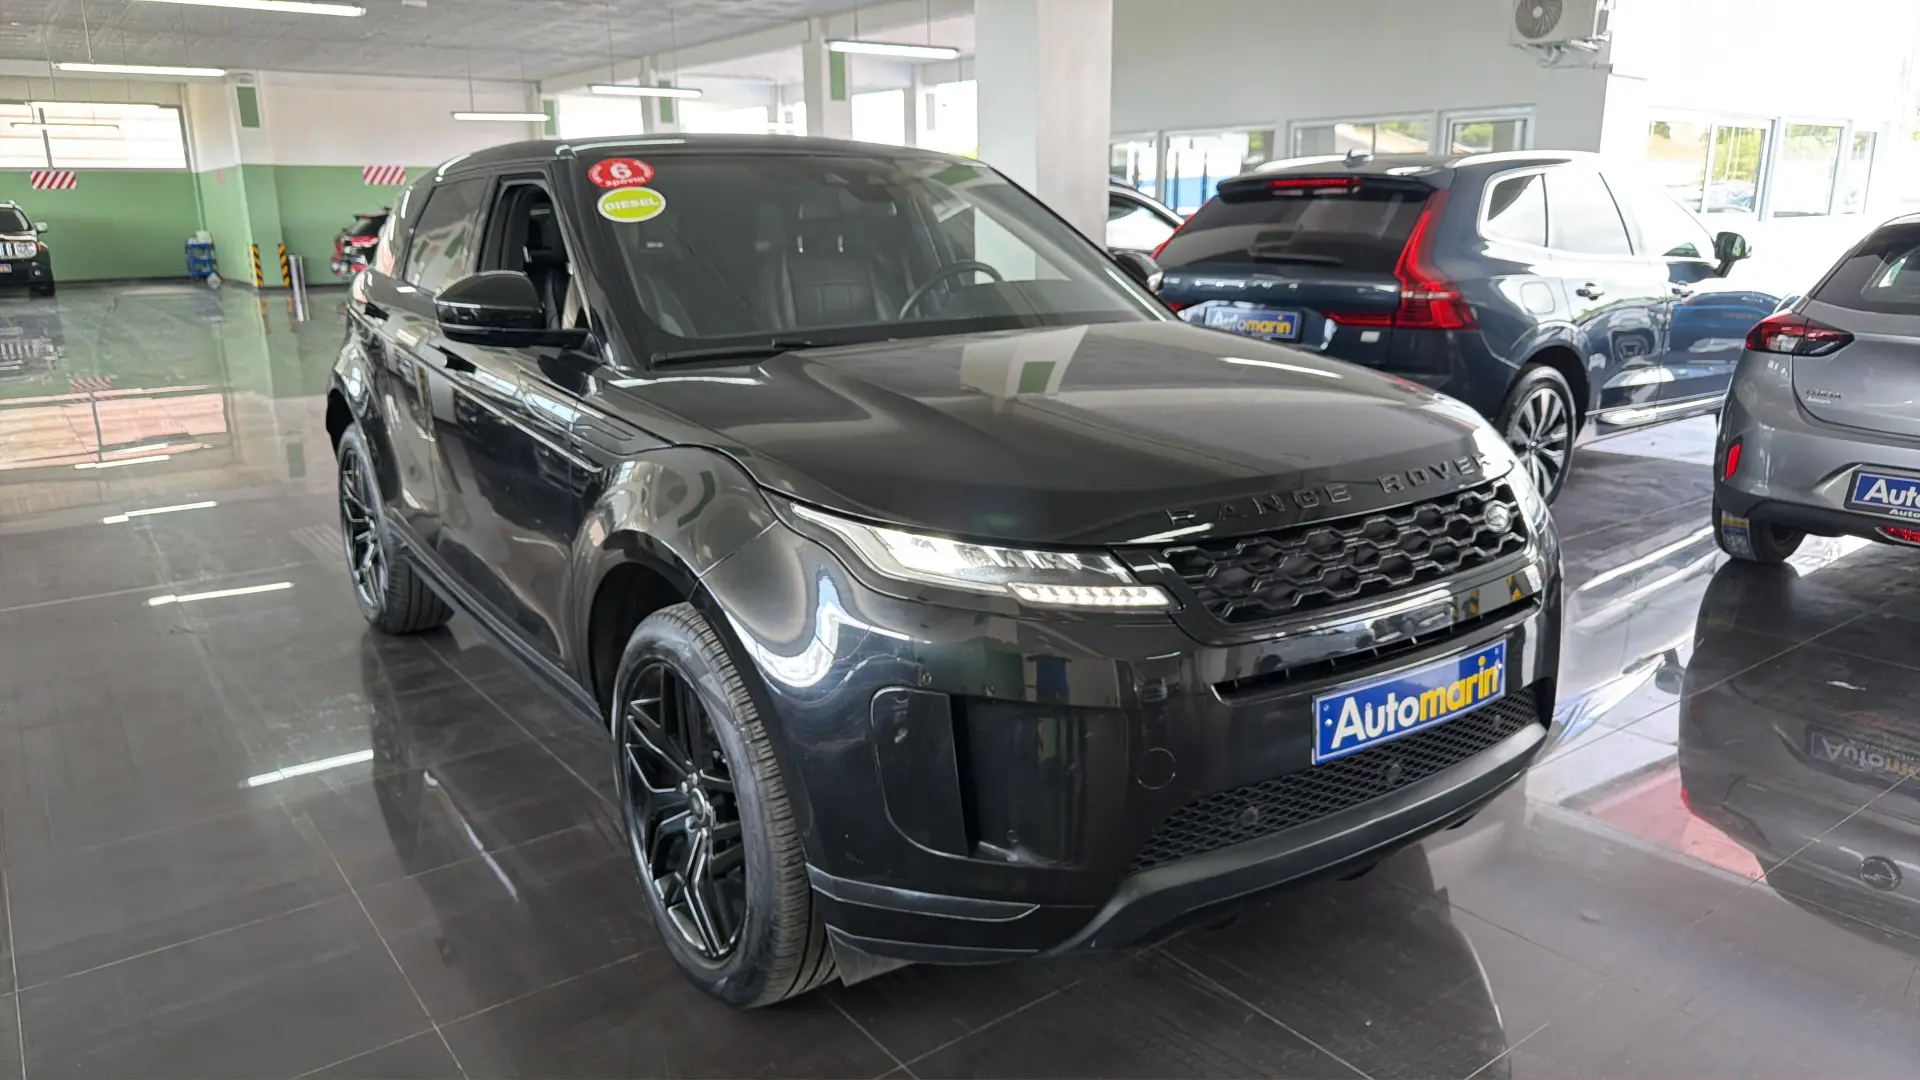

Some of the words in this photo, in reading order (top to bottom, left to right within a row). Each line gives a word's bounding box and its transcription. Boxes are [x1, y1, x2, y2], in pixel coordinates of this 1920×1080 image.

[609, 163, 632, 180] 6
[604, 198, 658, 211] DIESEL
[1165, 483, 1351, 526] RANGE
[1376, 451, 1492, 493] ROVER
[1330, 655, 1500, 750] Automarin
